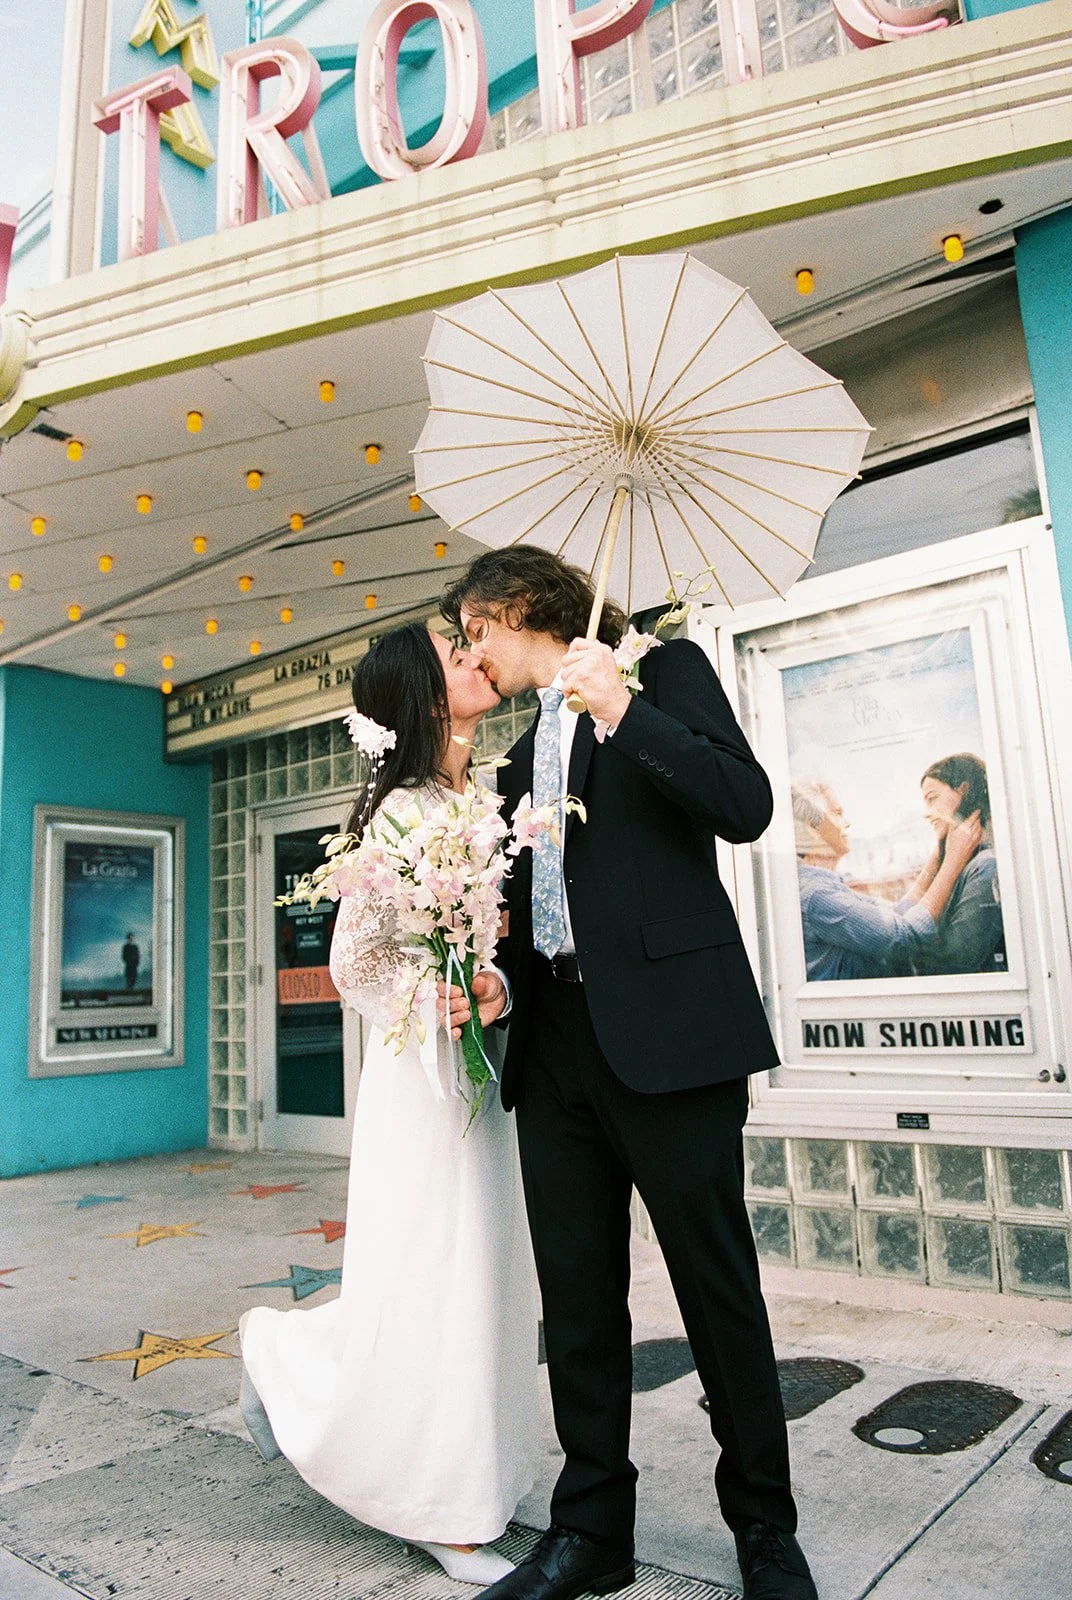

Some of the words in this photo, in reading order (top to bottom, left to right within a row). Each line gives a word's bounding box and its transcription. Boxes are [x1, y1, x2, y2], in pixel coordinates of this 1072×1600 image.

[92, 0, 962, 262] TROP
[274, 665, 288, 682] LA
[291, 650, 331, 677] GRAZIA
[317, 673, 331, 690] 76
[82, 860, 98, 876] La
[804, 1022, 865, 1048] NOW
[879, 1019, 1025, 1047] SHOWING
